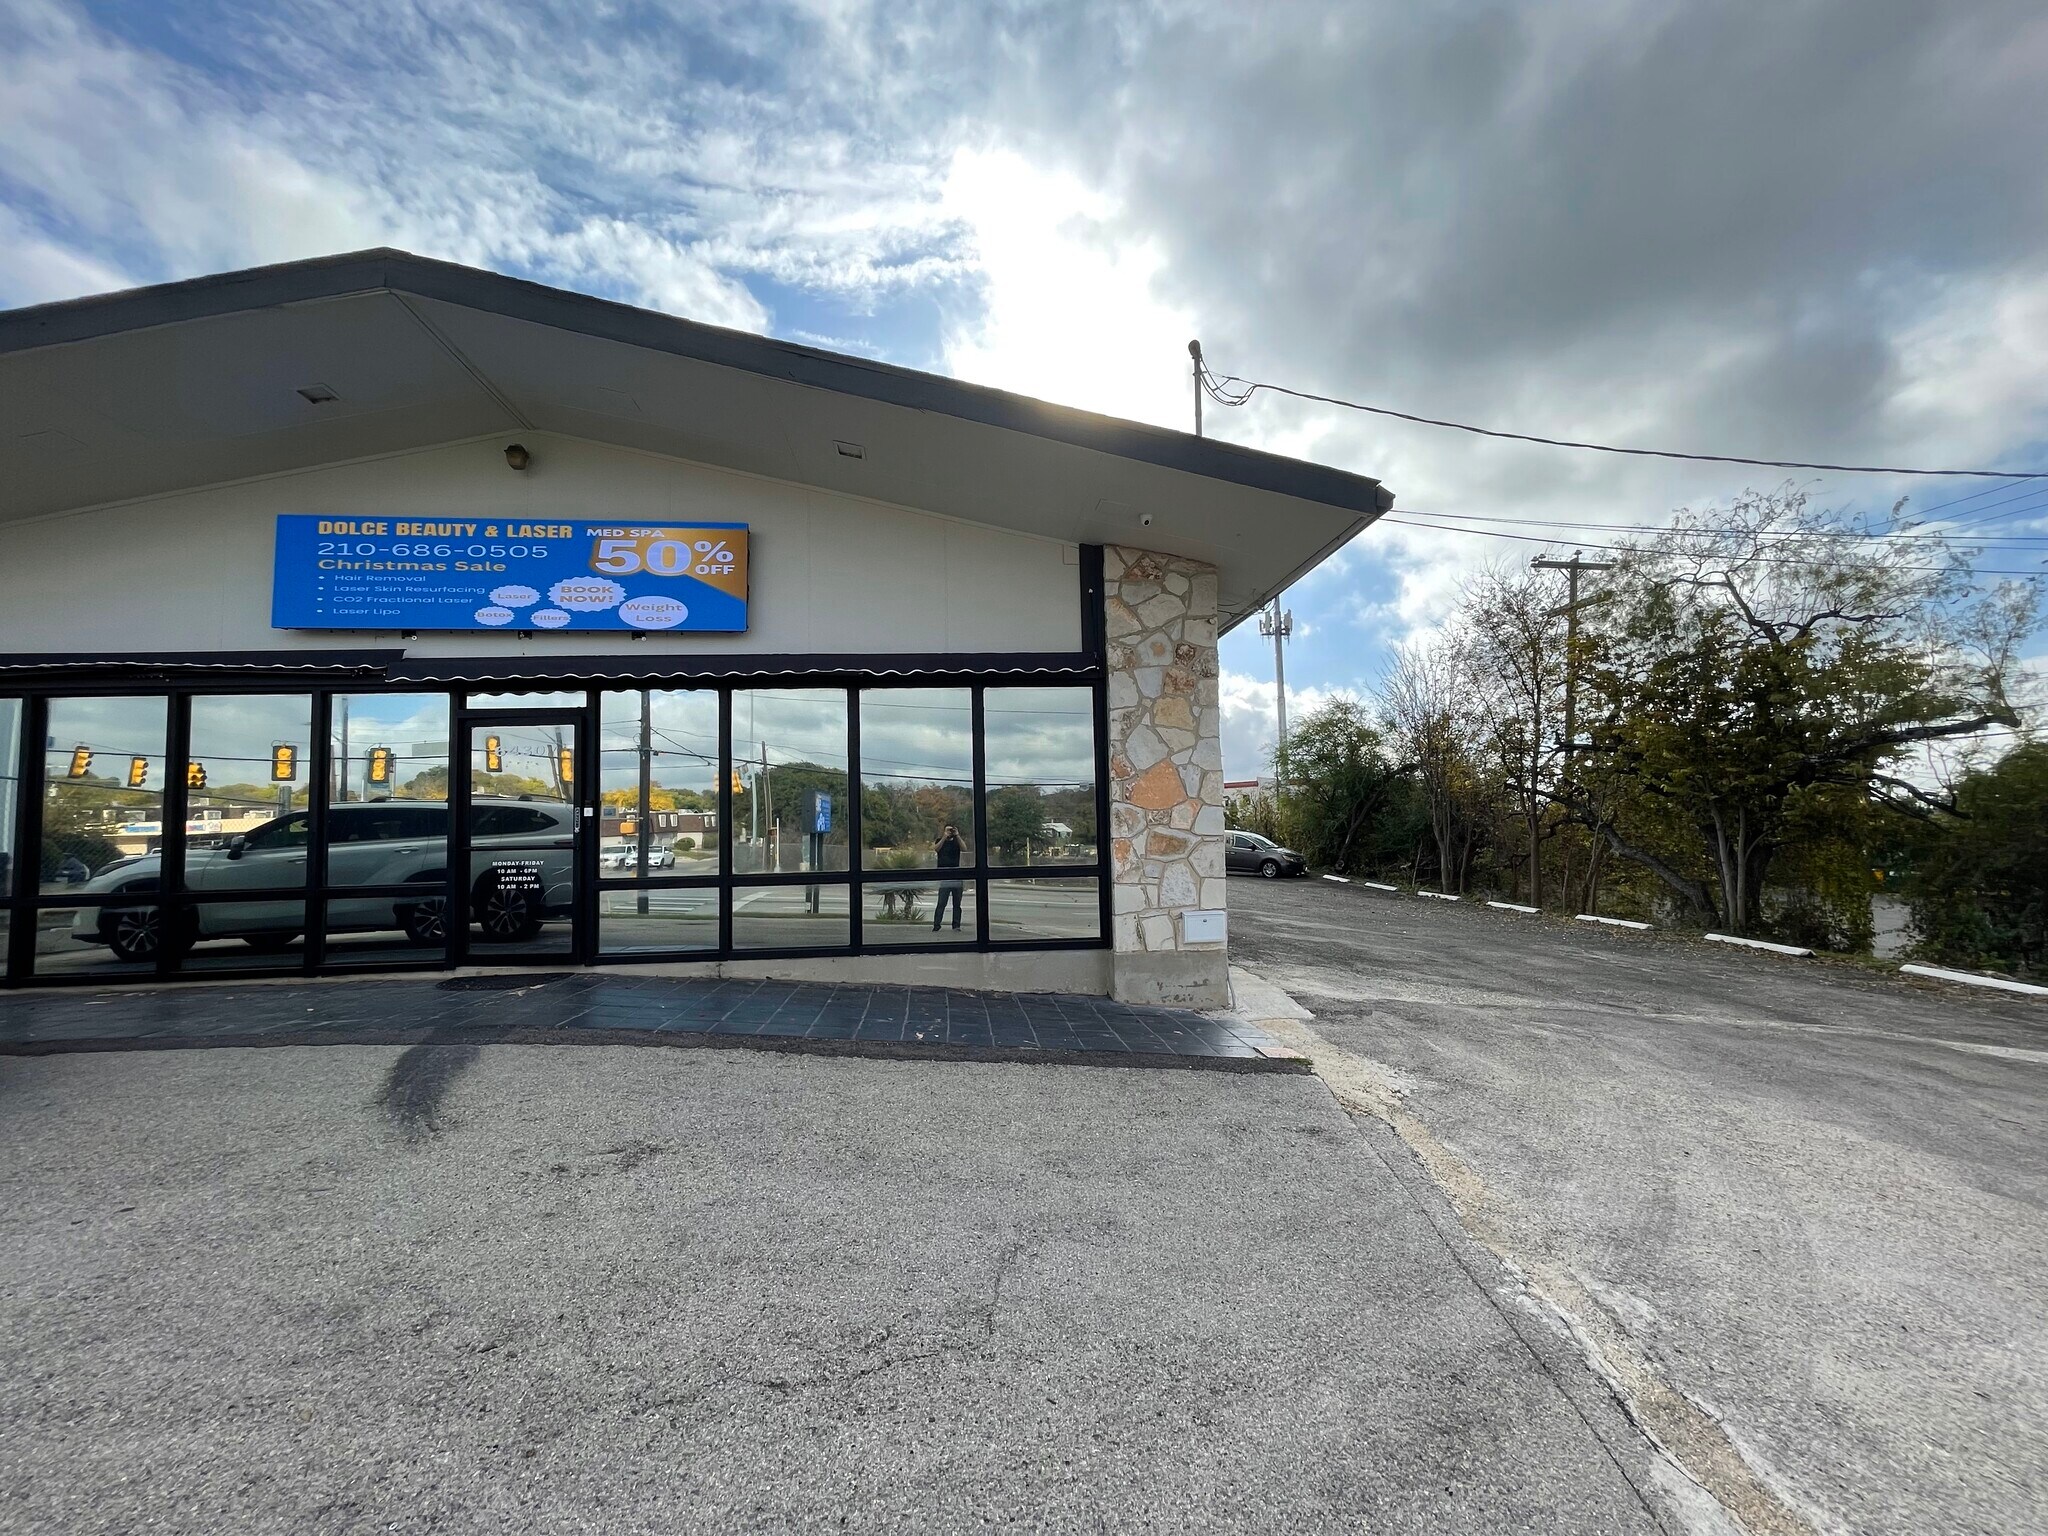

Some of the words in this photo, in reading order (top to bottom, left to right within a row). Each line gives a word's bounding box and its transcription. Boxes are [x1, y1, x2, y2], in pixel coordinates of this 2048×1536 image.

[318, 521, 388, 536] DOLCE
[396, 522, 477, 537] BEAUTY
[485, 525, 499, 537] &
[507, 524, 573, 538] LASER
[586, 528, 625, 537] MED
[629, 528, 665, 538] SPA
[317, 542, 548, 558] 210-686-0505
[318, 559, 447, 571] Christmas
[454, 561, 506, 572] Sale
[695, 564, 735, 575] OFF
[334, 574, 362, 582] Hair
[374, 585, 402, 593] Skin
[405, 586, 486, 595] Resurfacing
[560, 585, 613, 594] BOOK
[366, 596, 435, 604] Fractional
[560, 594, 614, 603] NOW!
[373, 608, 401, 617] Lipo
[624, 603, 683, 613] Weight
[635, 614, 672, 622] Loss
